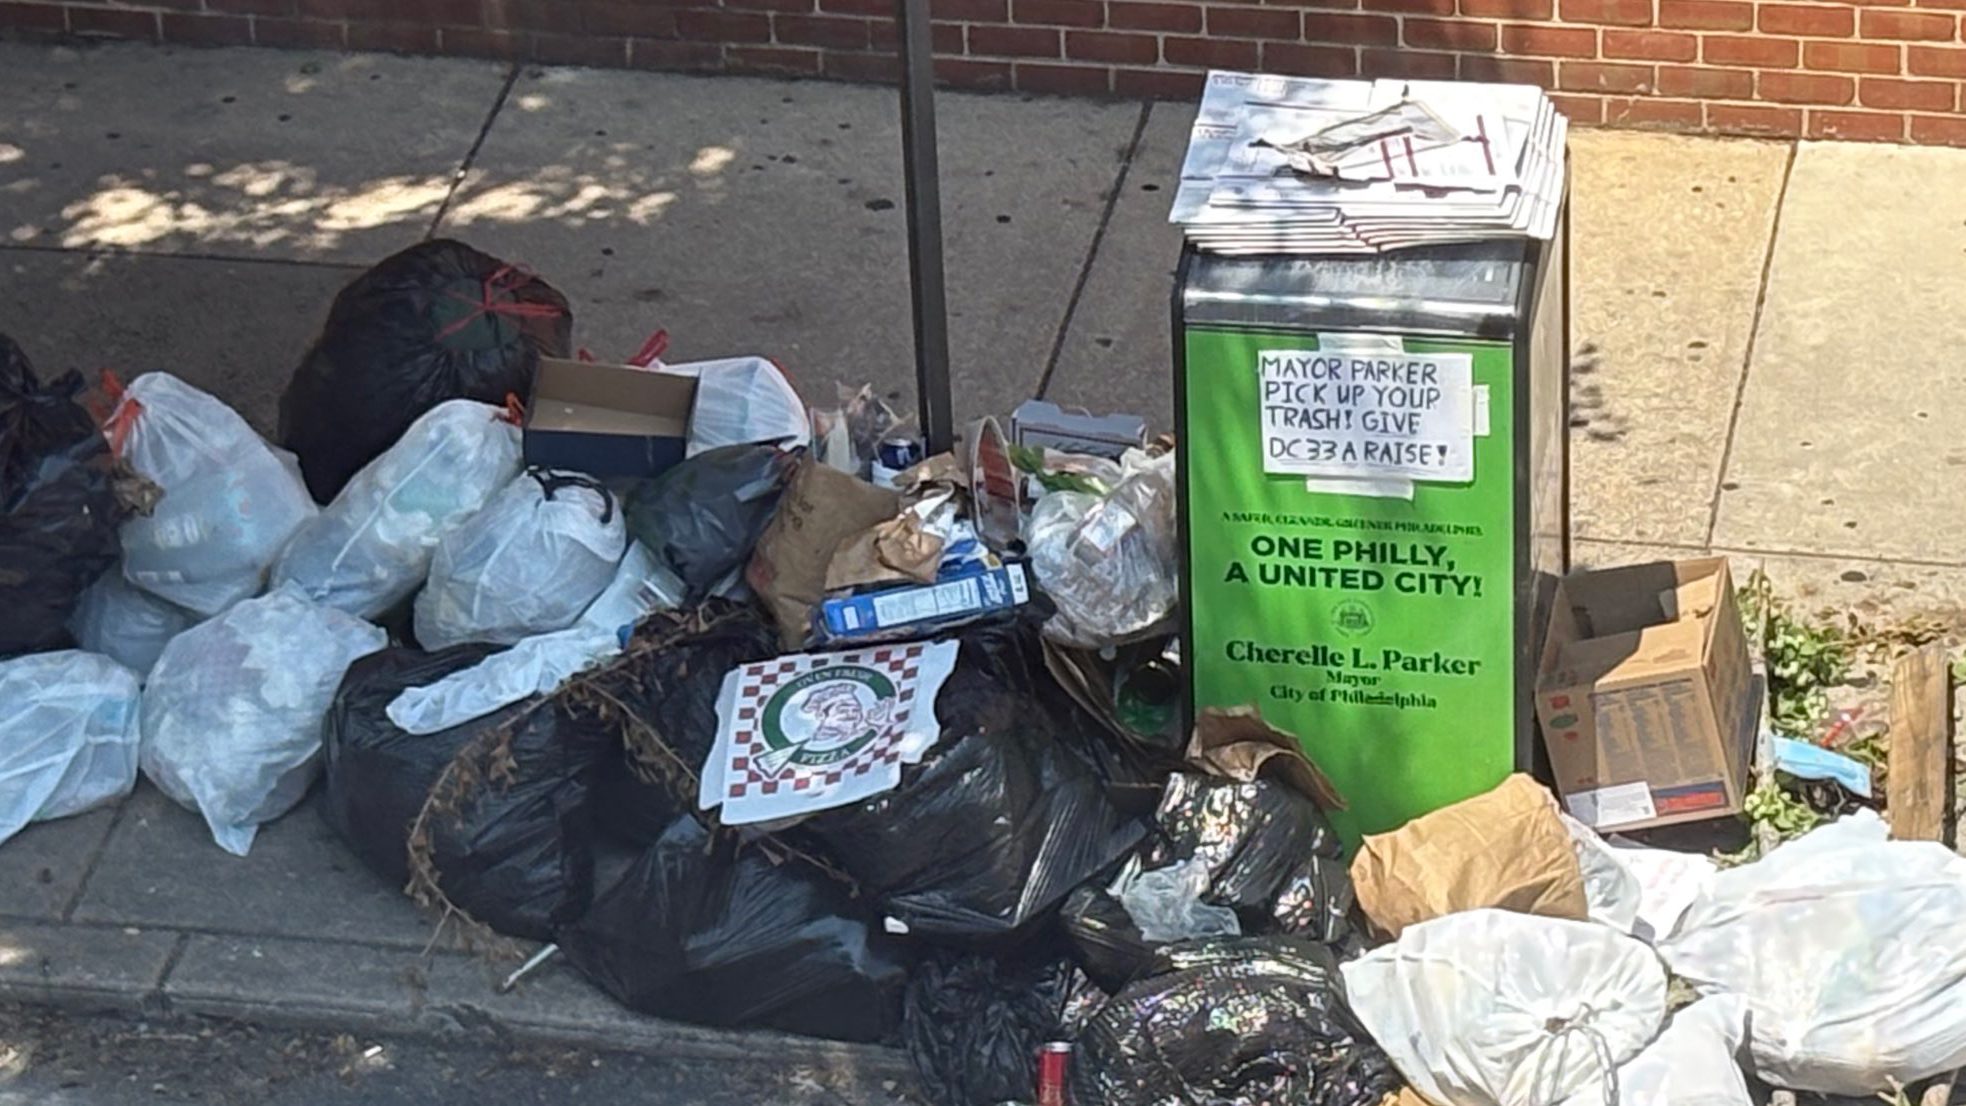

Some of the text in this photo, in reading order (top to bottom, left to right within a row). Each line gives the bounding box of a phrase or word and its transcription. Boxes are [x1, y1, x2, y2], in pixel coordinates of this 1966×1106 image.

[1261, 357, 1438, 384] MAYOR PARKER
[1265, 382, 1441, 410] PICK UP YOUR
[1265, 406, 1422, 435] TRASH! GIVE
[1341, 440, 1358, 462] A
[1364, 442, 1448, 466] RAISE!
[1250, 535, 1455, 571] ONE PHILLY,
[1224, 562, 1483, 598] A UNITED CITY!
[1226, 640, 1482, 676] Cherelle L. Parker
[1326, 670, 1381, 687] Mayor
[1270, 685, 1303, 702] City
[1308, 688, 1326, 702] of
